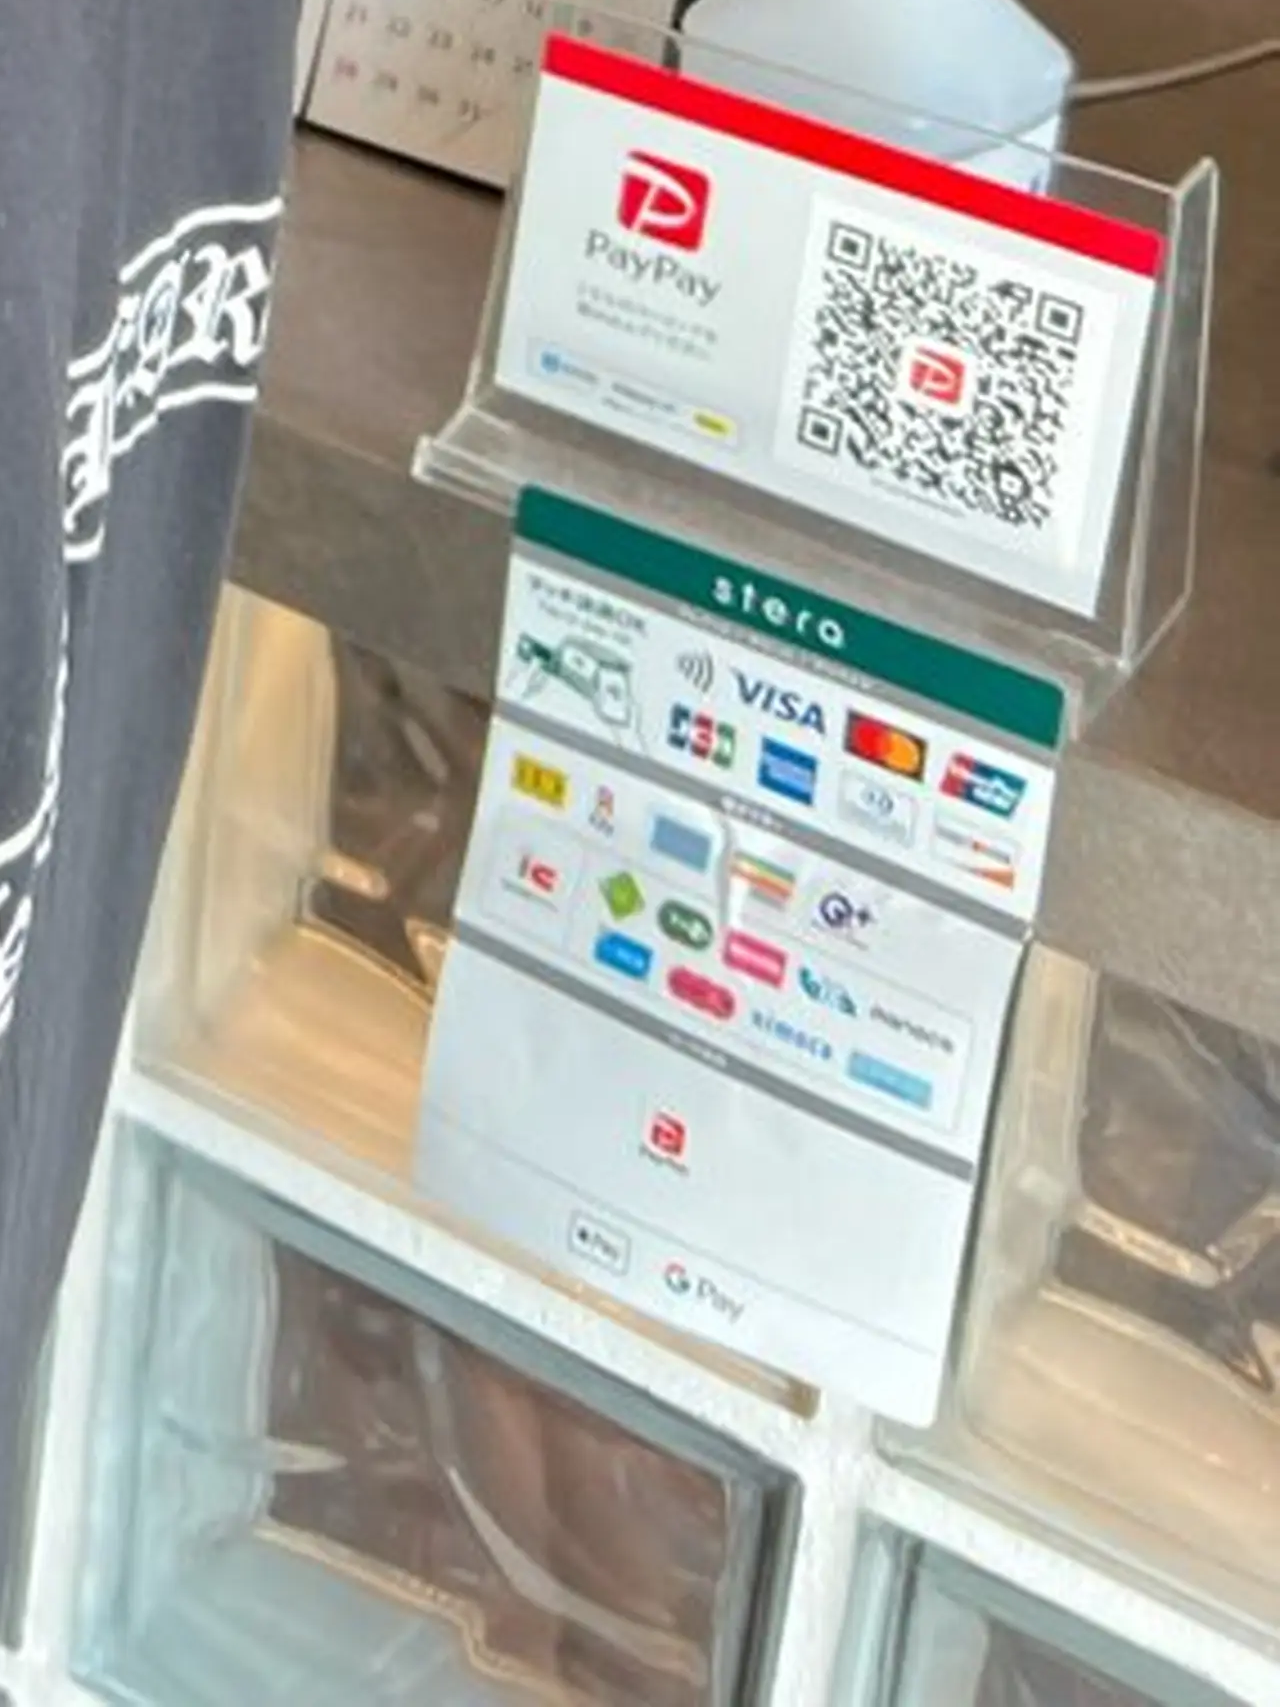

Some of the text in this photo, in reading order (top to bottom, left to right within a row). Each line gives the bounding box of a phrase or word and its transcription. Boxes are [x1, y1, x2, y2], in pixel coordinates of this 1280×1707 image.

[584, 229, 722, 308] PayPay
[712, 575, 847, 648] stera
[730, 666, 827, 736] VISA
[697, 1276, 745, 1324] Pay
